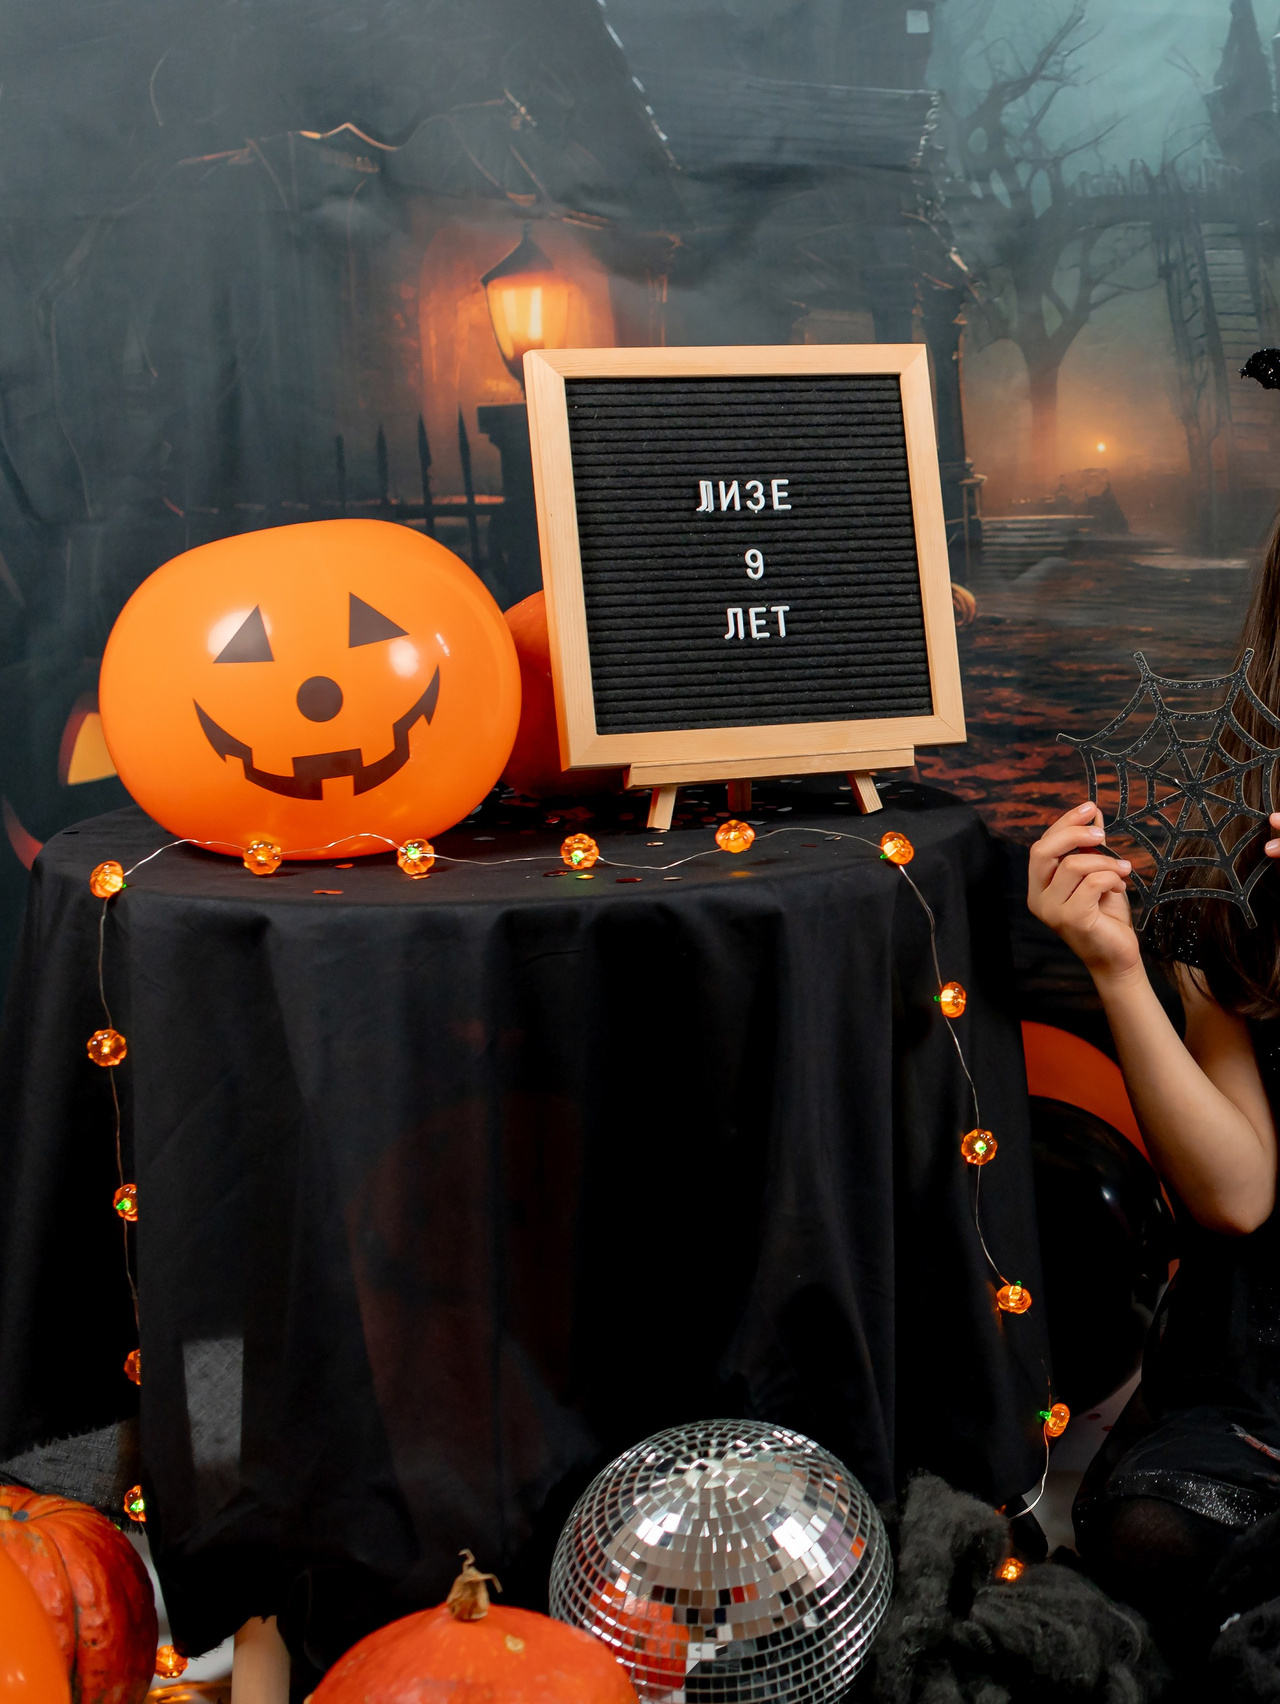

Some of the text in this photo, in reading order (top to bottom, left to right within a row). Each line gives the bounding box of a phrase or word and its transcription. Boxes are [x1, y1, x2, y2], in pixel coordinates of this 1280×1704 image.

[696, 479, 792, 513] ЛИЗЕ
[744, 548, 765, 580] 9
[724, 605, 790, 640] ЛЕТ
